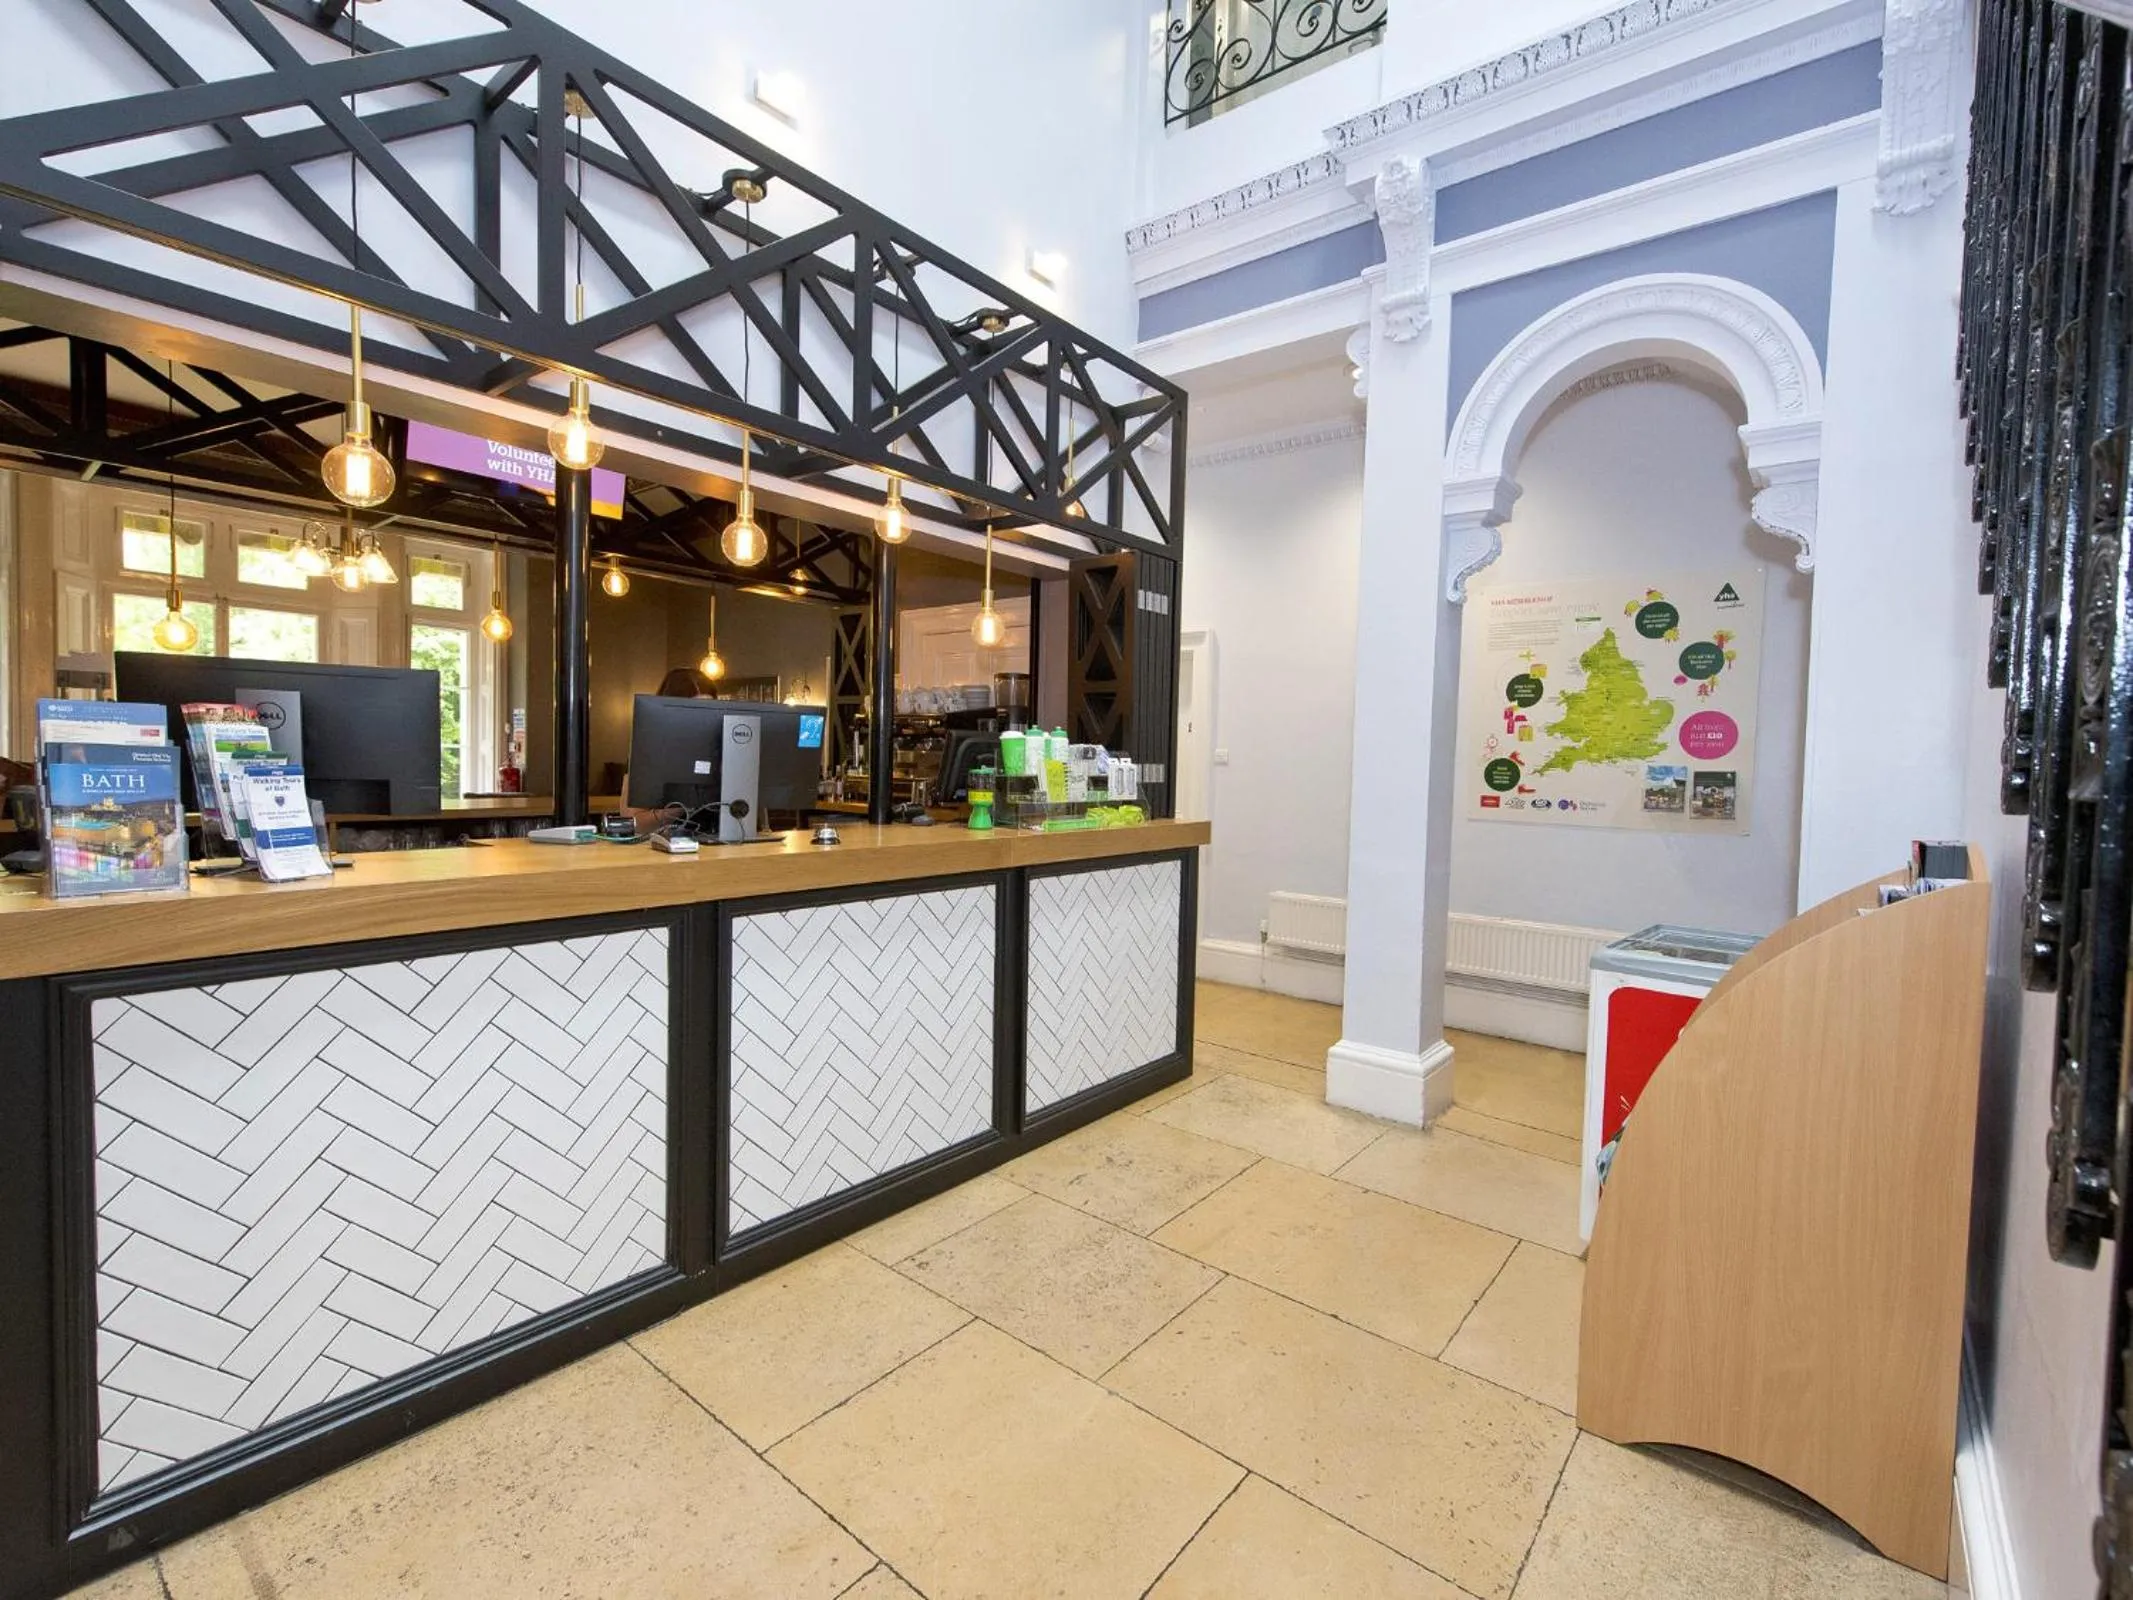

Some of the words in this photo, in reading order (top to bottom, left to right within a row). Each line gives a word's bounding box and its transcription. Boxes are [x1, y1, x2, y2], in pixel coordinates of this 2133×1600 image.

[487, 458, 523, 476] with
[82, 773, 145, 788] BATH
[252, 777, 280, 785] Walking
